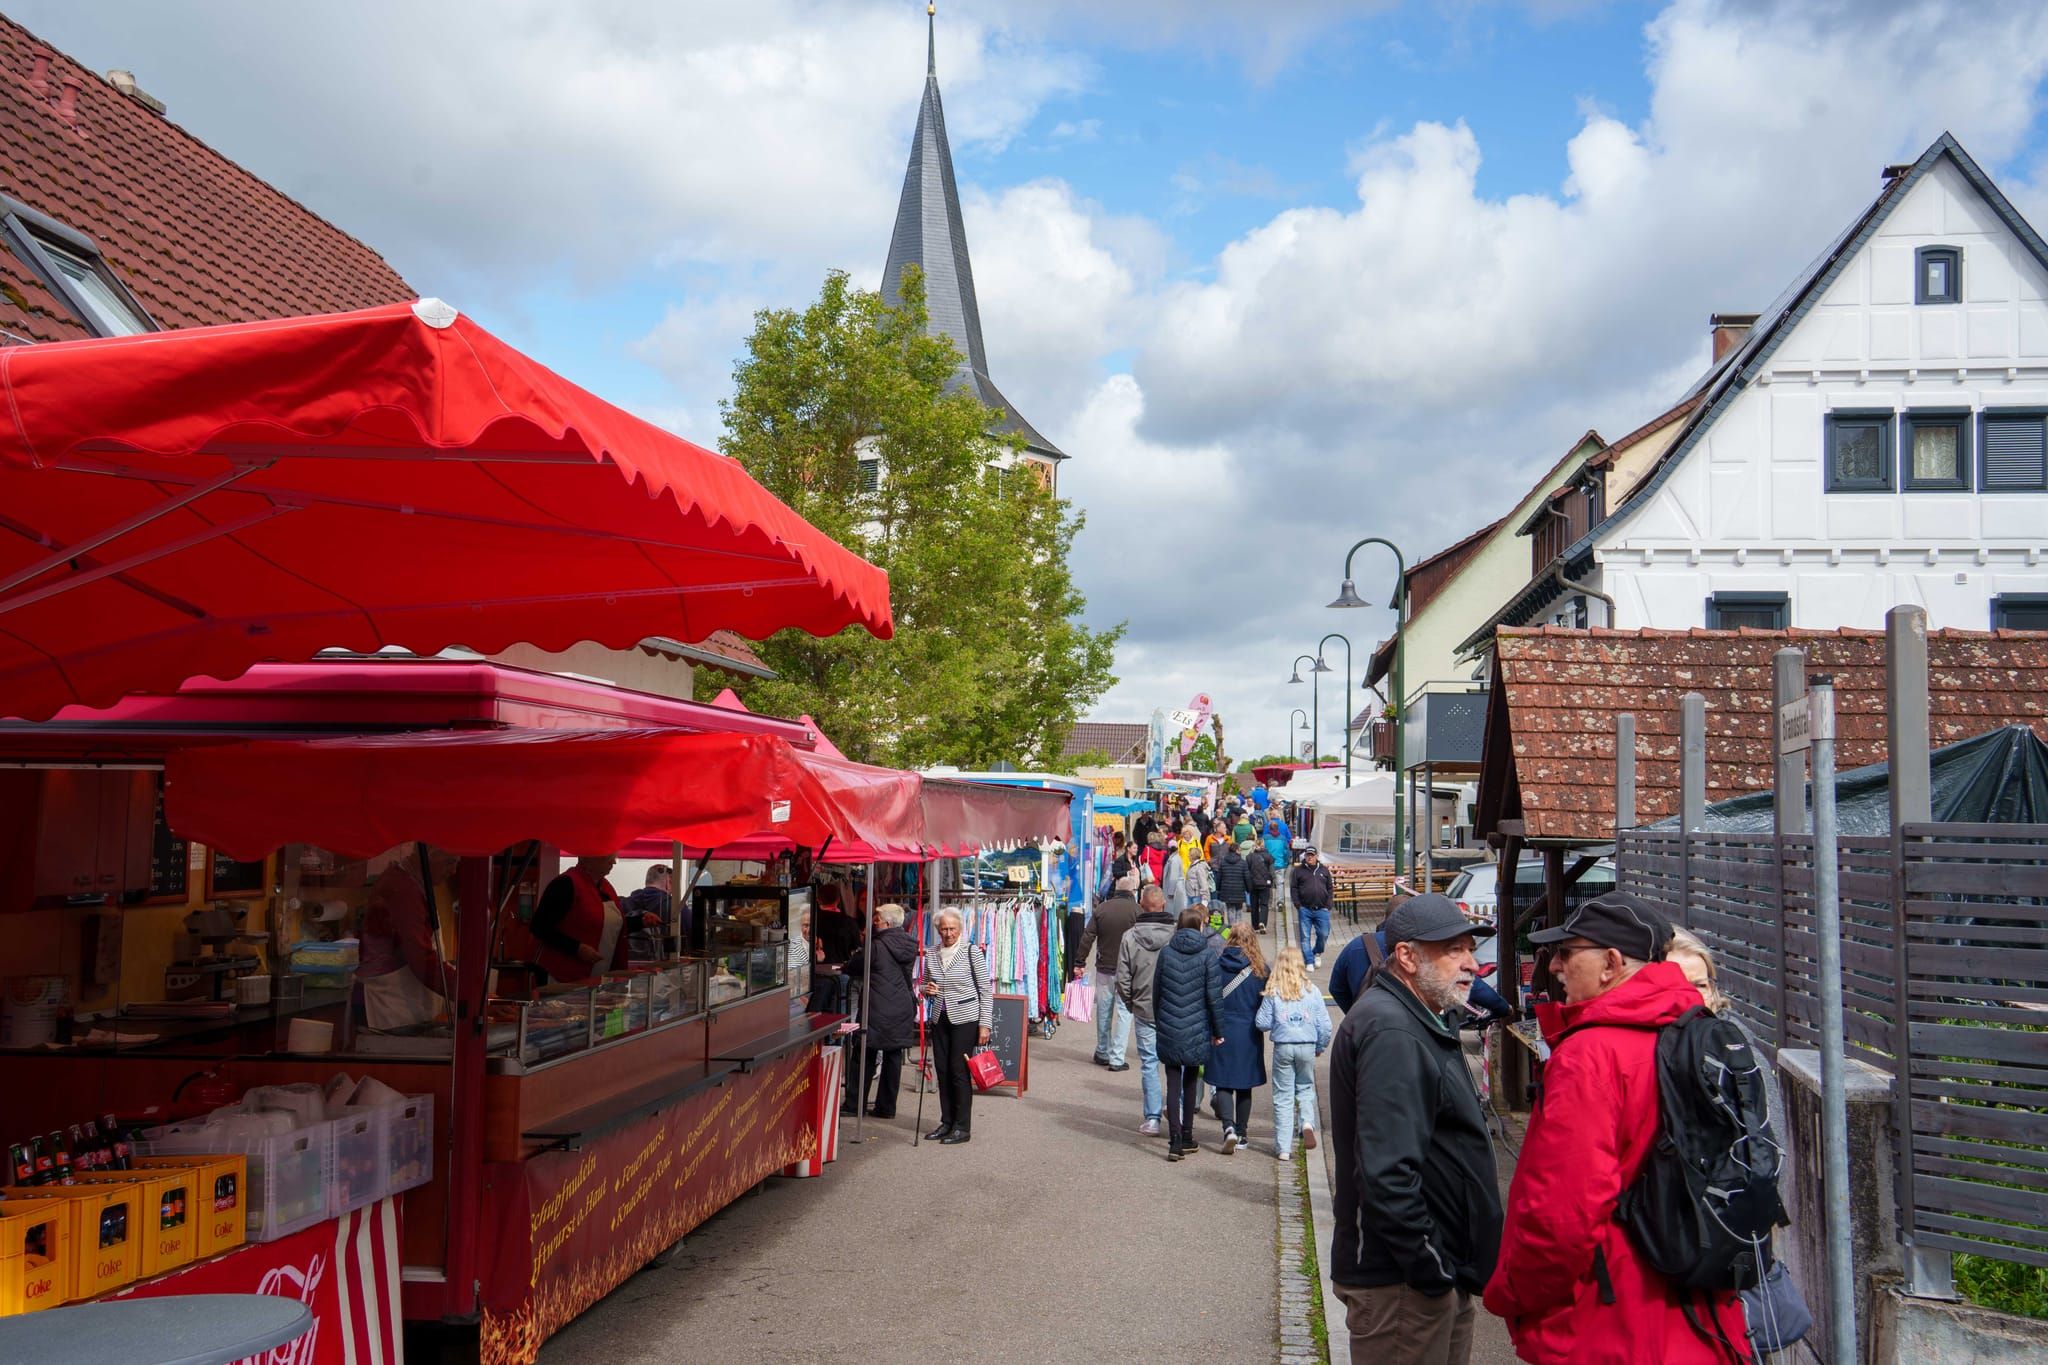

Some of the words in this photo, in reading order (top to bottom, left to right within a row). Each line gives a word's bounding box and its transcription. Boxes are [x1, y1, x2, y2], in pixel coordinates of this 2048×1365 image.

[1172, 710, 1193, 726] Eis
[1010, 868, 1026, 879] 10
[621, 1126, 665, 1188] Feuerwurst
[585, 1176, 608, 1217] Haut
[214, 1221, 234, 1239] Coke
[160, 1239, 181, 1256] Coke
[97, 1258, 122, 1279] Coke
[26, 1278, 52, 1299] Coke
